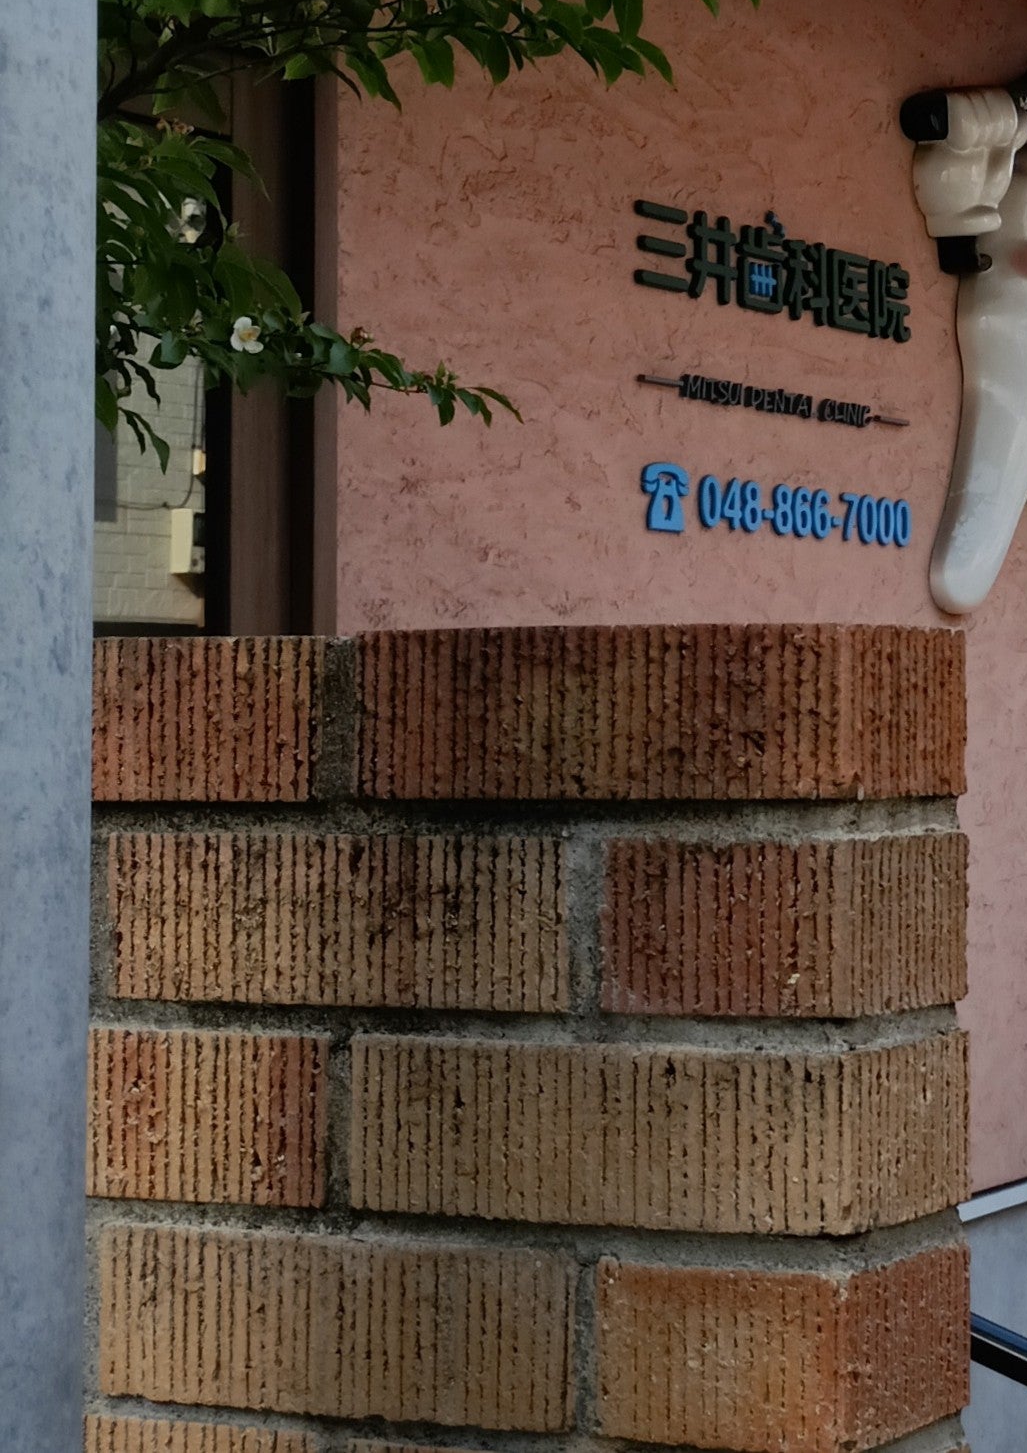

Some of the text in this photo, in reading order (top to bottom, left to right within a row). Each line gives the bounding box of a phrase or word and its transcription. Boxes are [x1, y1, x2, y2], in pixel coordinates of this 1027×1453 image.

[634, 199, 912, 343] 三井歯科医院
[679, 373, 745, 407] MITSUI
[817, 398, 872, 428] CLINIC
[699, 474, 912, 547] 048-866-7000
